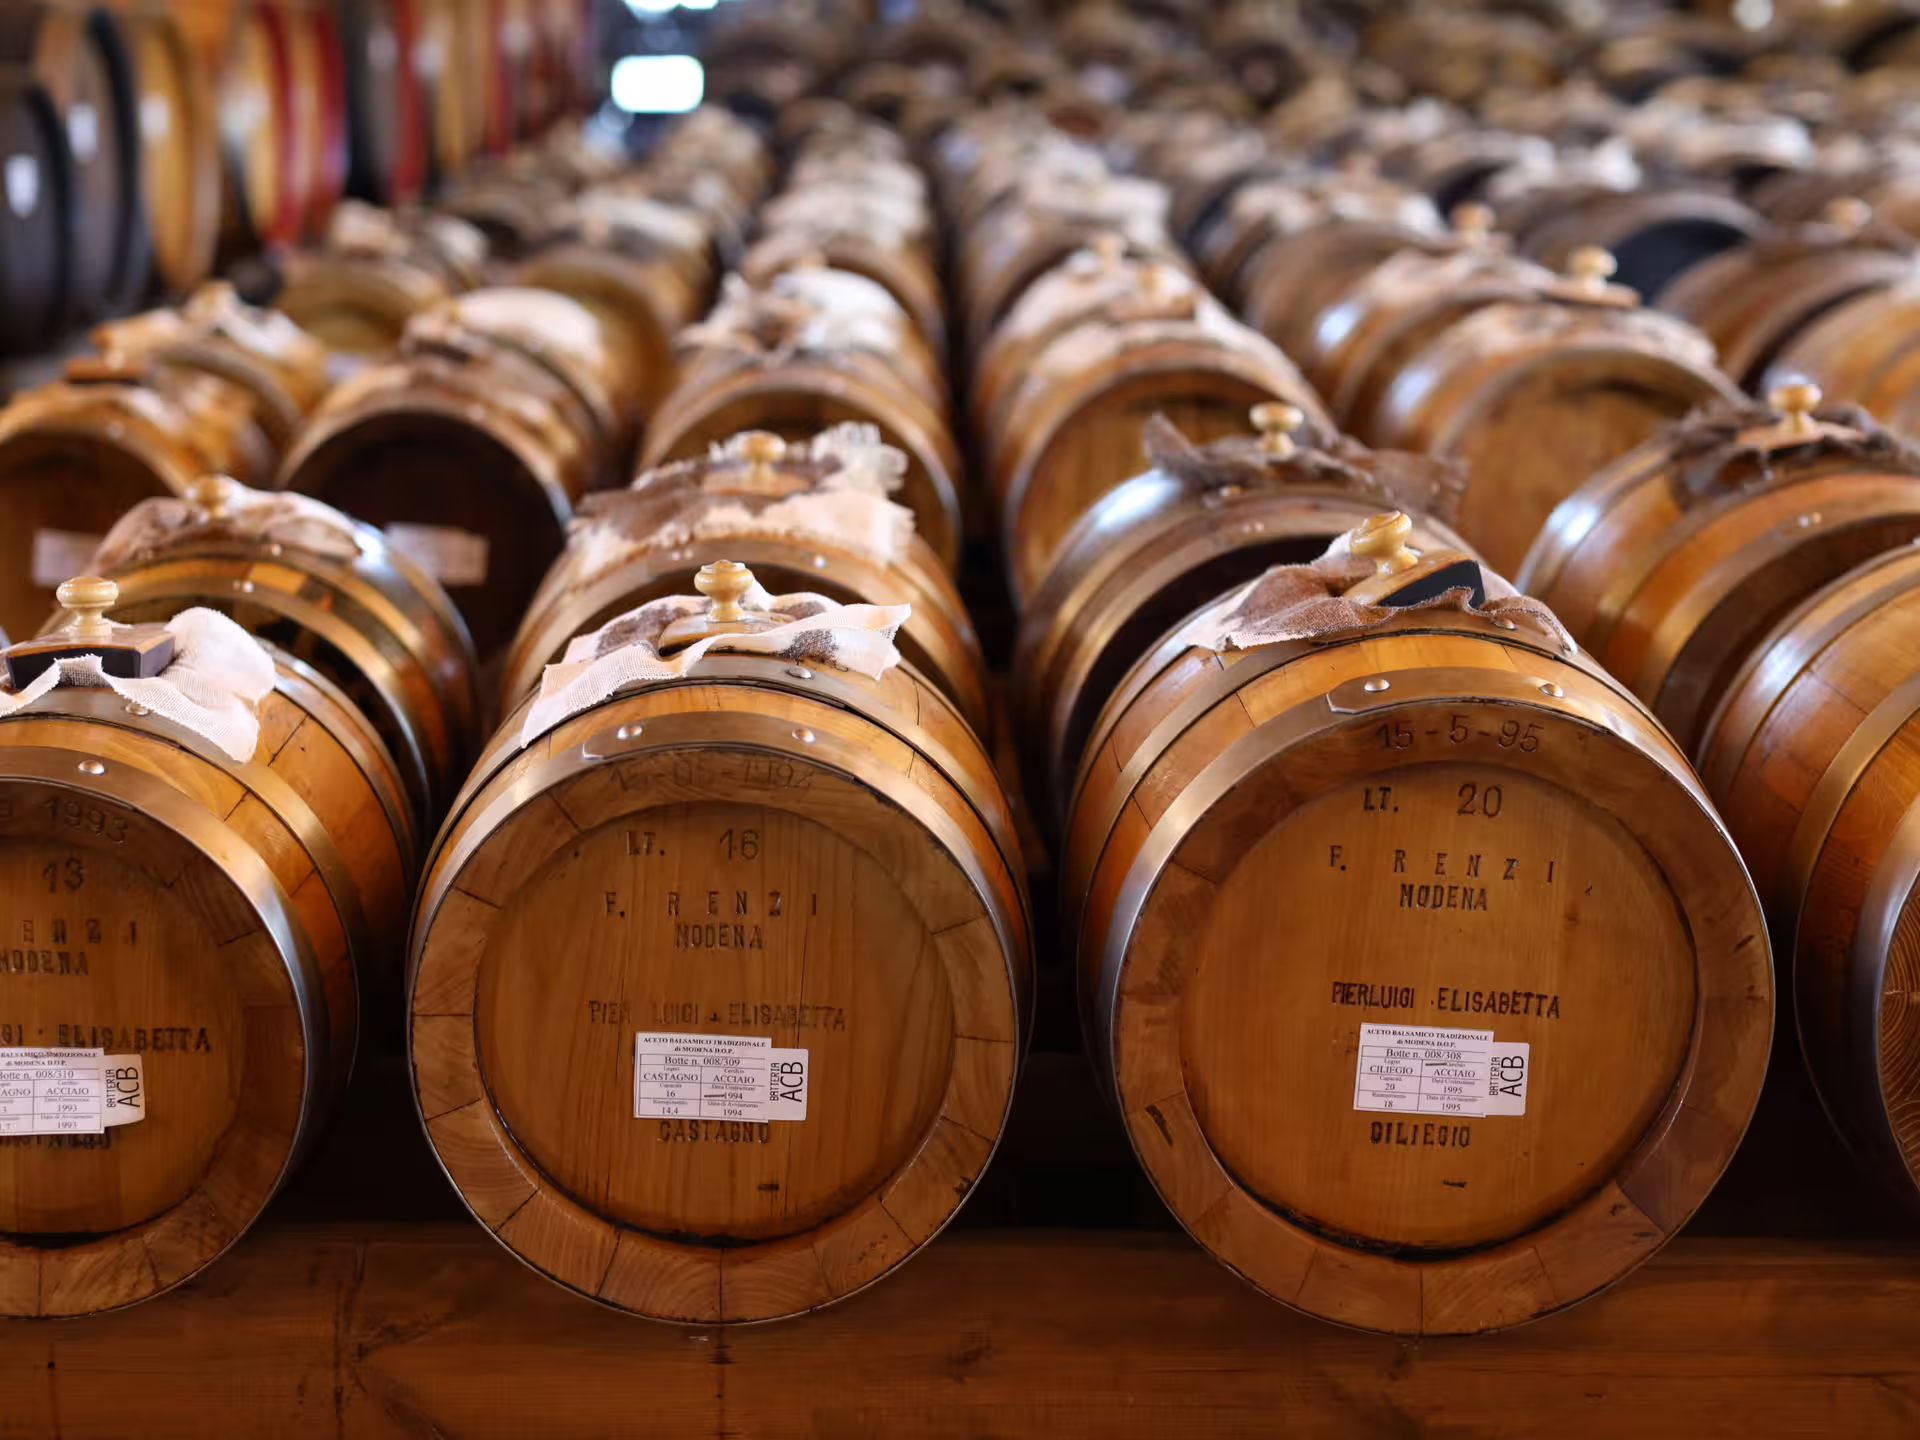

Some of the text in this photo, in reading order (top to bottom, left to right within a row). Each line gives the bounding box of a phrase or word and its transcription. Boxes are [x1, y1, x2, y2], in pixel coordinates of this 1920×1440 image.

[1363, 783, 1502, 817] LT. 20
[719, 828, 760, 861] 16
[1329, 845, 1347, 871] F.
[1400, 884, 1488, 911] MODENA
[605, 891, 625, 918] F.
[675, 923, 763, 950] MODENA
[1331, 981, 1415, 1010] PIERLUIGI
[57, 1023, 211, 1054] ELISABETTA
[1392, 1030, 1435, 1038] BALSAMICO
[1436, 1032, 1489, 1041] TRADIZIONALE
[669, 1037, 712, 1045] BALSAMICO
[713, 1039, 767, 1048] TRADIZIONALE
[1404, 1039, 1436, 1047] MODENA
[714, 1047, 735, 1055] D.O.P.
[1386, 1048, 1411, 1057] Botte
[1424, 1050, 1462, 1060] 008/308
[664, 1055, 689, 1065] Botte
[703, 1057, 741, 1067] 008/309
[35, 1070, 75, 1079] 008/310
[1369, 1064, 1414, 1075] CILIEGIO
[1433, 1068, 1476, 1078] ACCIAIO
[643, 1072, 699, 1082] CASTAGNO
[712, 1074, 755, 1084] ACCIAIO
[769, 1062, 780, 1102] BATTERIA
[780, 1061, 804, 1103] ACB
[1488, 1057, 1501, 1096] BATTERIA
[1500, 1056, 1524, 1098] ACB
[46, 1087, 90, 1096] ACCIAIO
[105, 1069, 117, 1108] BATTERIA
[115, 1066, 141, 1108] ACB
[1384, 1083, 1396, 1091] 20
[1444, 1085, 1463, 1094] 1995
[665, 1089, 676, 1098] 16
[723, 1091, 743, 1100] 1994
[57, 1104, 78, 1113] 1993
[1384, 1100, 1394, 1108] 18
[1442, 1103, 1461, 1111] 1995
[723, 1108, 743, 1117] 1994
[57, 1121, 78, 1129] 1993
